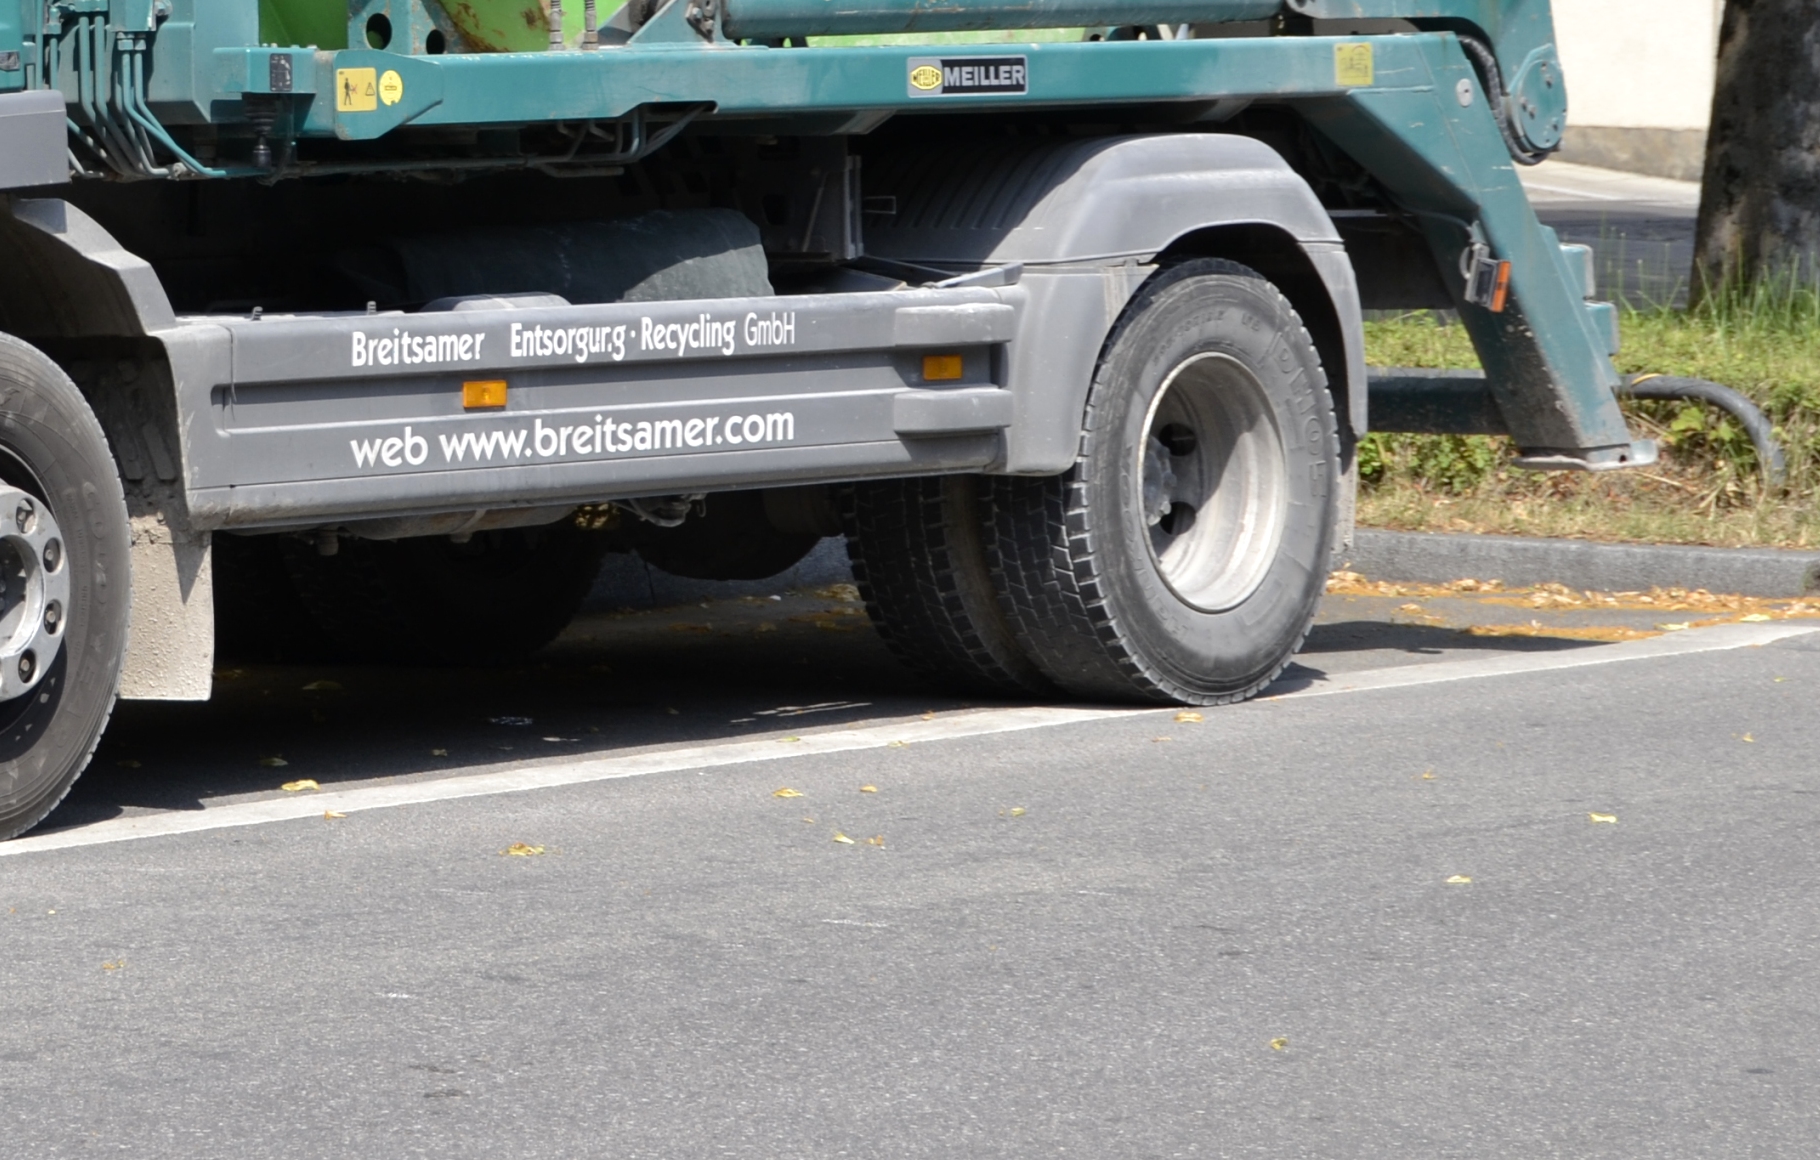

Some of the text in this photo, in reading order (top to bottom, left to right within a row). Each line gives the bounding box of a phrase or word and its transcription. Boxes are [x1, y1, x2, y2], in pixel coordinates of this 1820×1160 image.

[943, 65, 1025, 87] MEILLER
[352, 328, 486, 367] Breitsamer
[641, 313, 736, 356] Recycling
[744, 312, 796, 346] GmbH
[350, 411, 795, 469] web www.breitsamer.com
